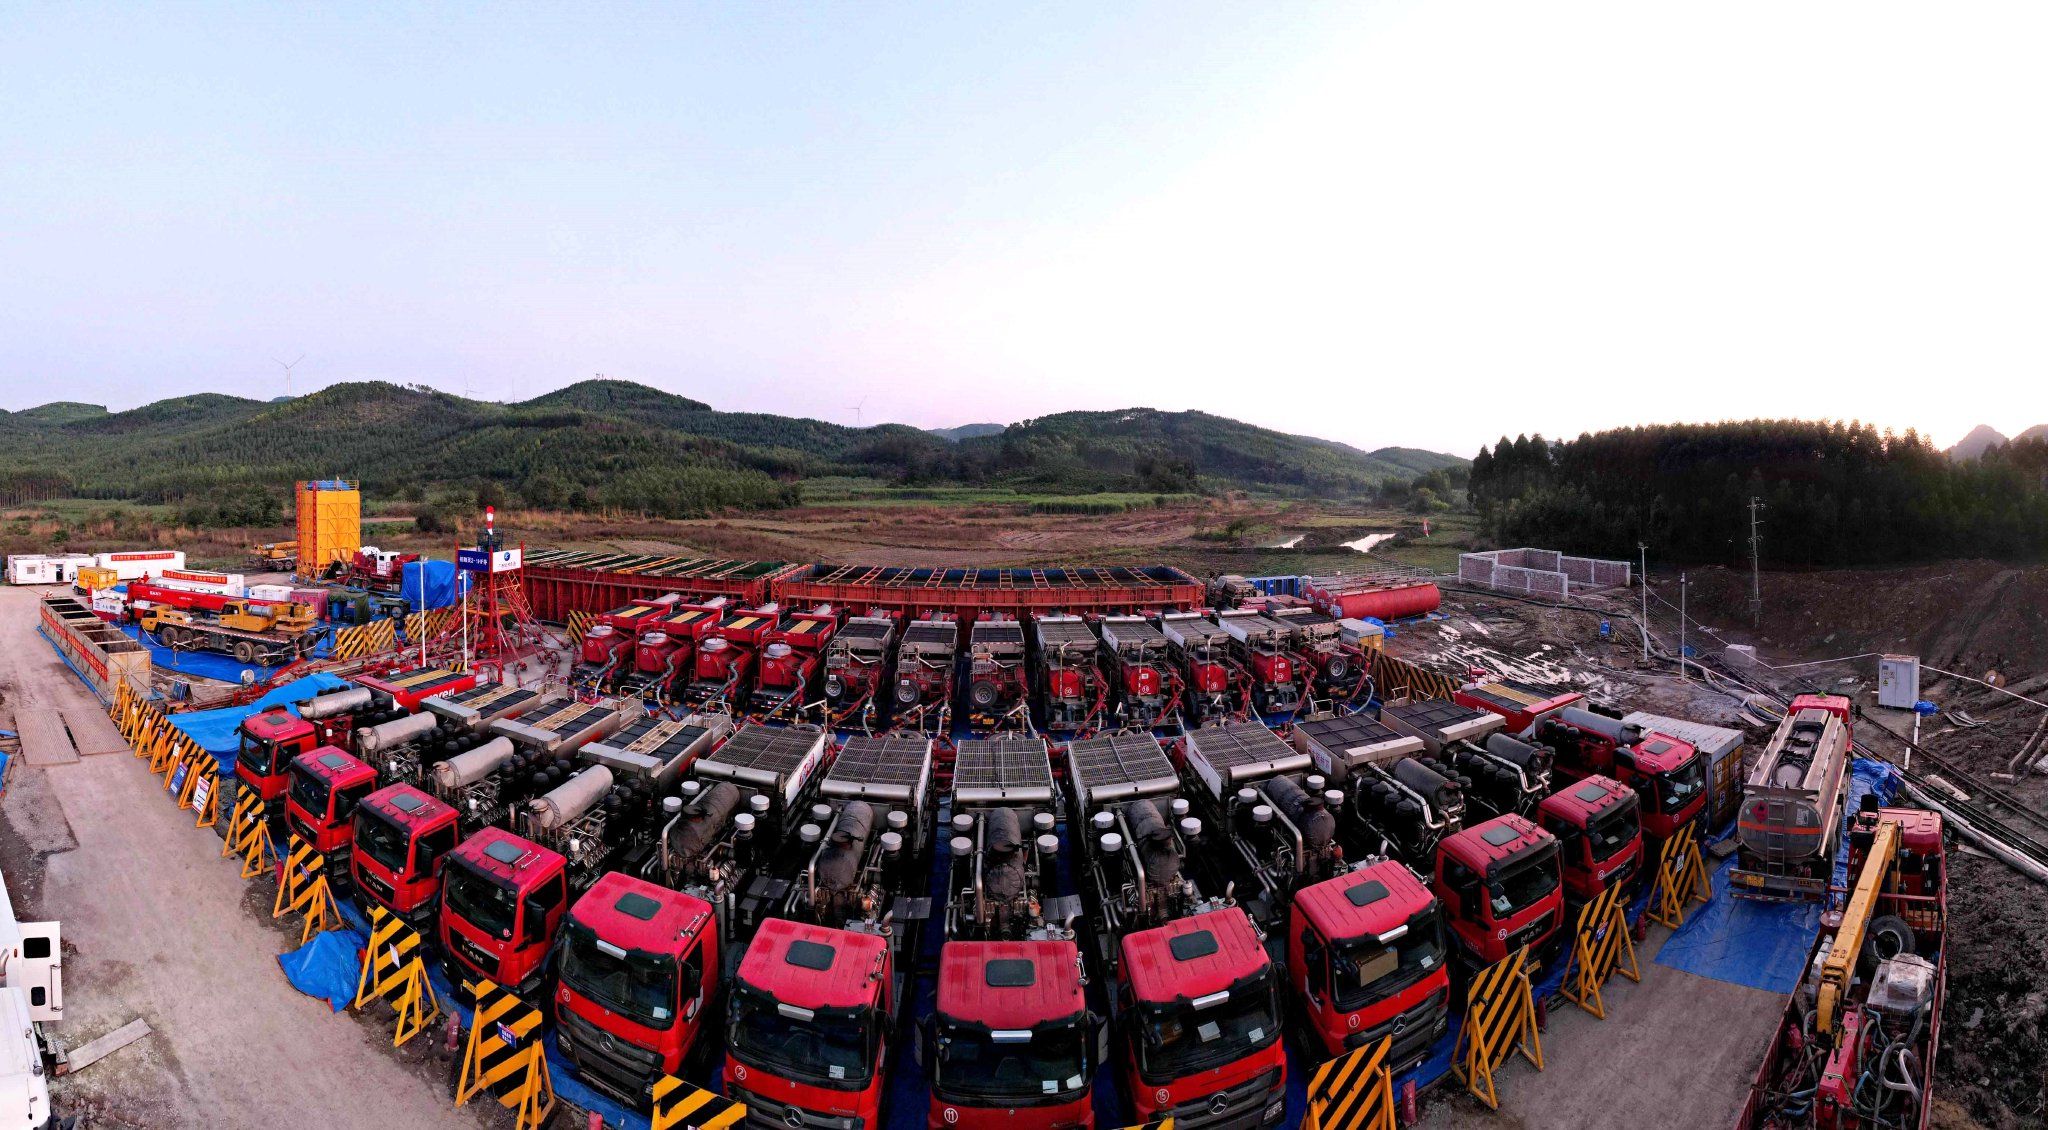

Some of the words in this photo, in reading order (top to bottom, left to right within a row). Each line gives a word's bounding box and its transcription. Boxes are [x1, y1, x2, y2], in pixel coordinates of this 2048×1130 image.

[563, 990, 570, 1001] 3
[1157, 1090, 1168, 1102] 15
[946, 1109, 957, 1122] 11
